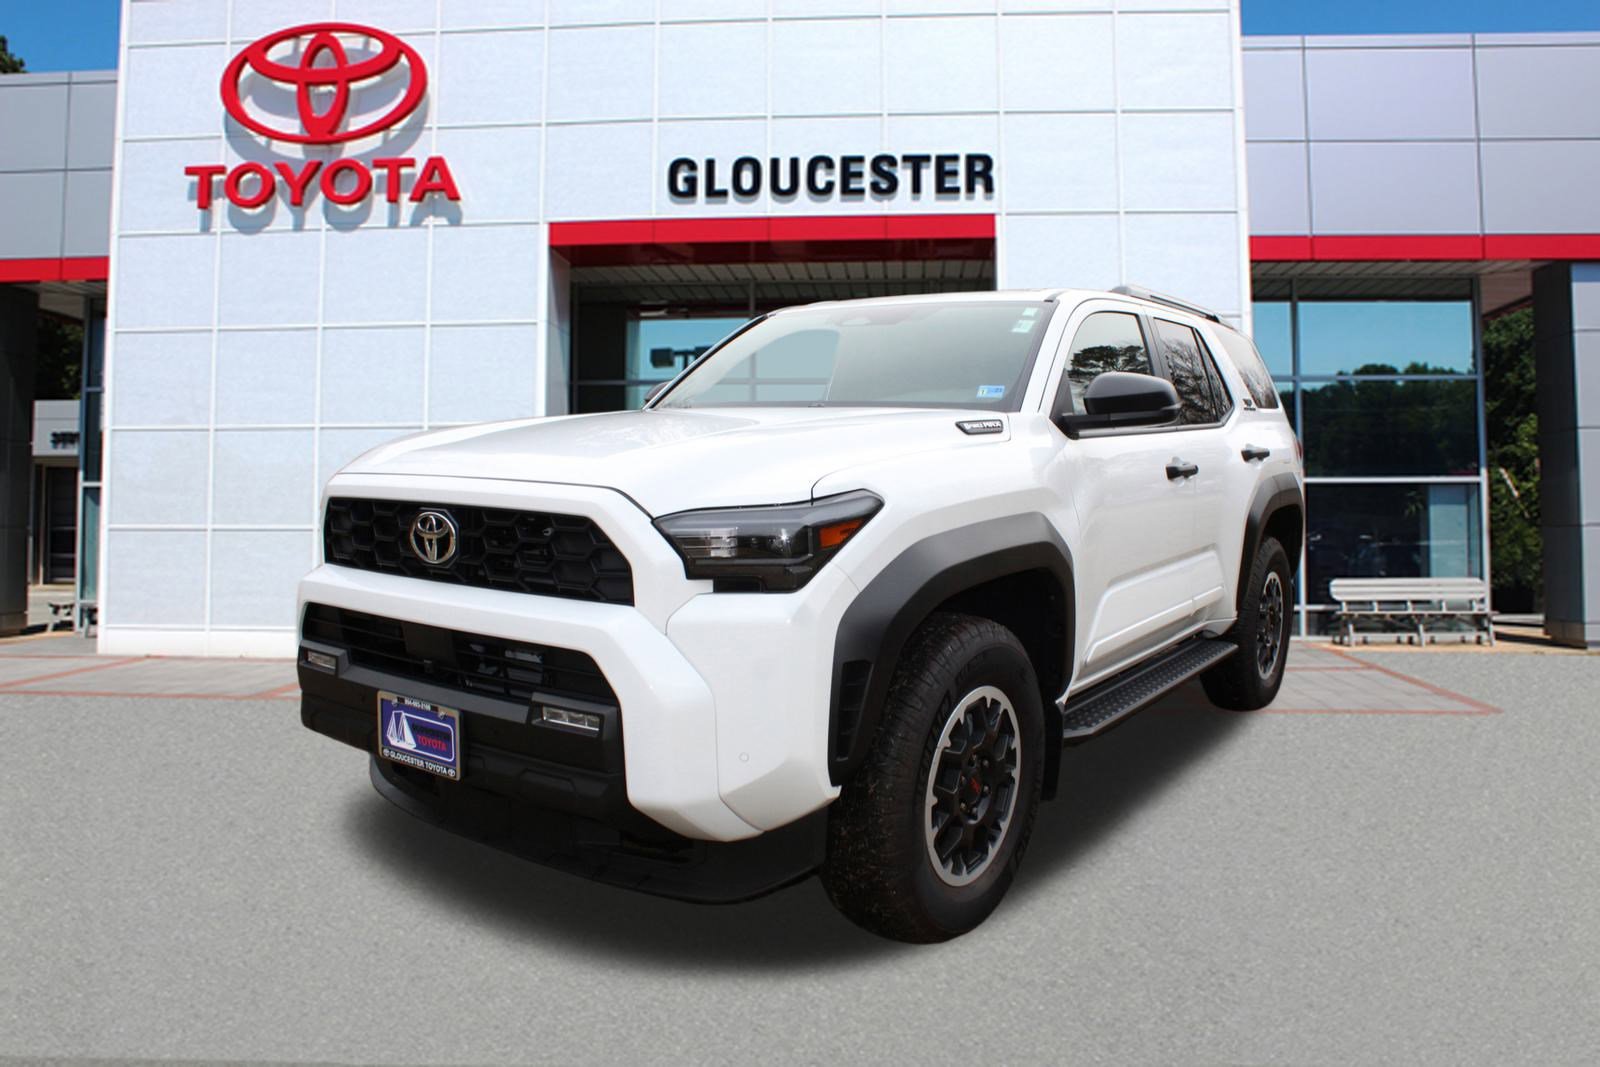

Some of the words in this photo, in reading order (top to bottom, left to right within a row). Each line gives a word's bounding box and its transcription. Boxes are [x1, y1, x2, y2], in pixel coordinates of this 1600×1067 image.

[185, 156, 461, 209] TOYOTA
[668, 154, 994, 199] GLOUCESTER
[417, 735, 447, 751] TOYOTA
[390, 751, 425, 768] GLOUCESTER
[425, 761, 447, 774] TOYOTA
